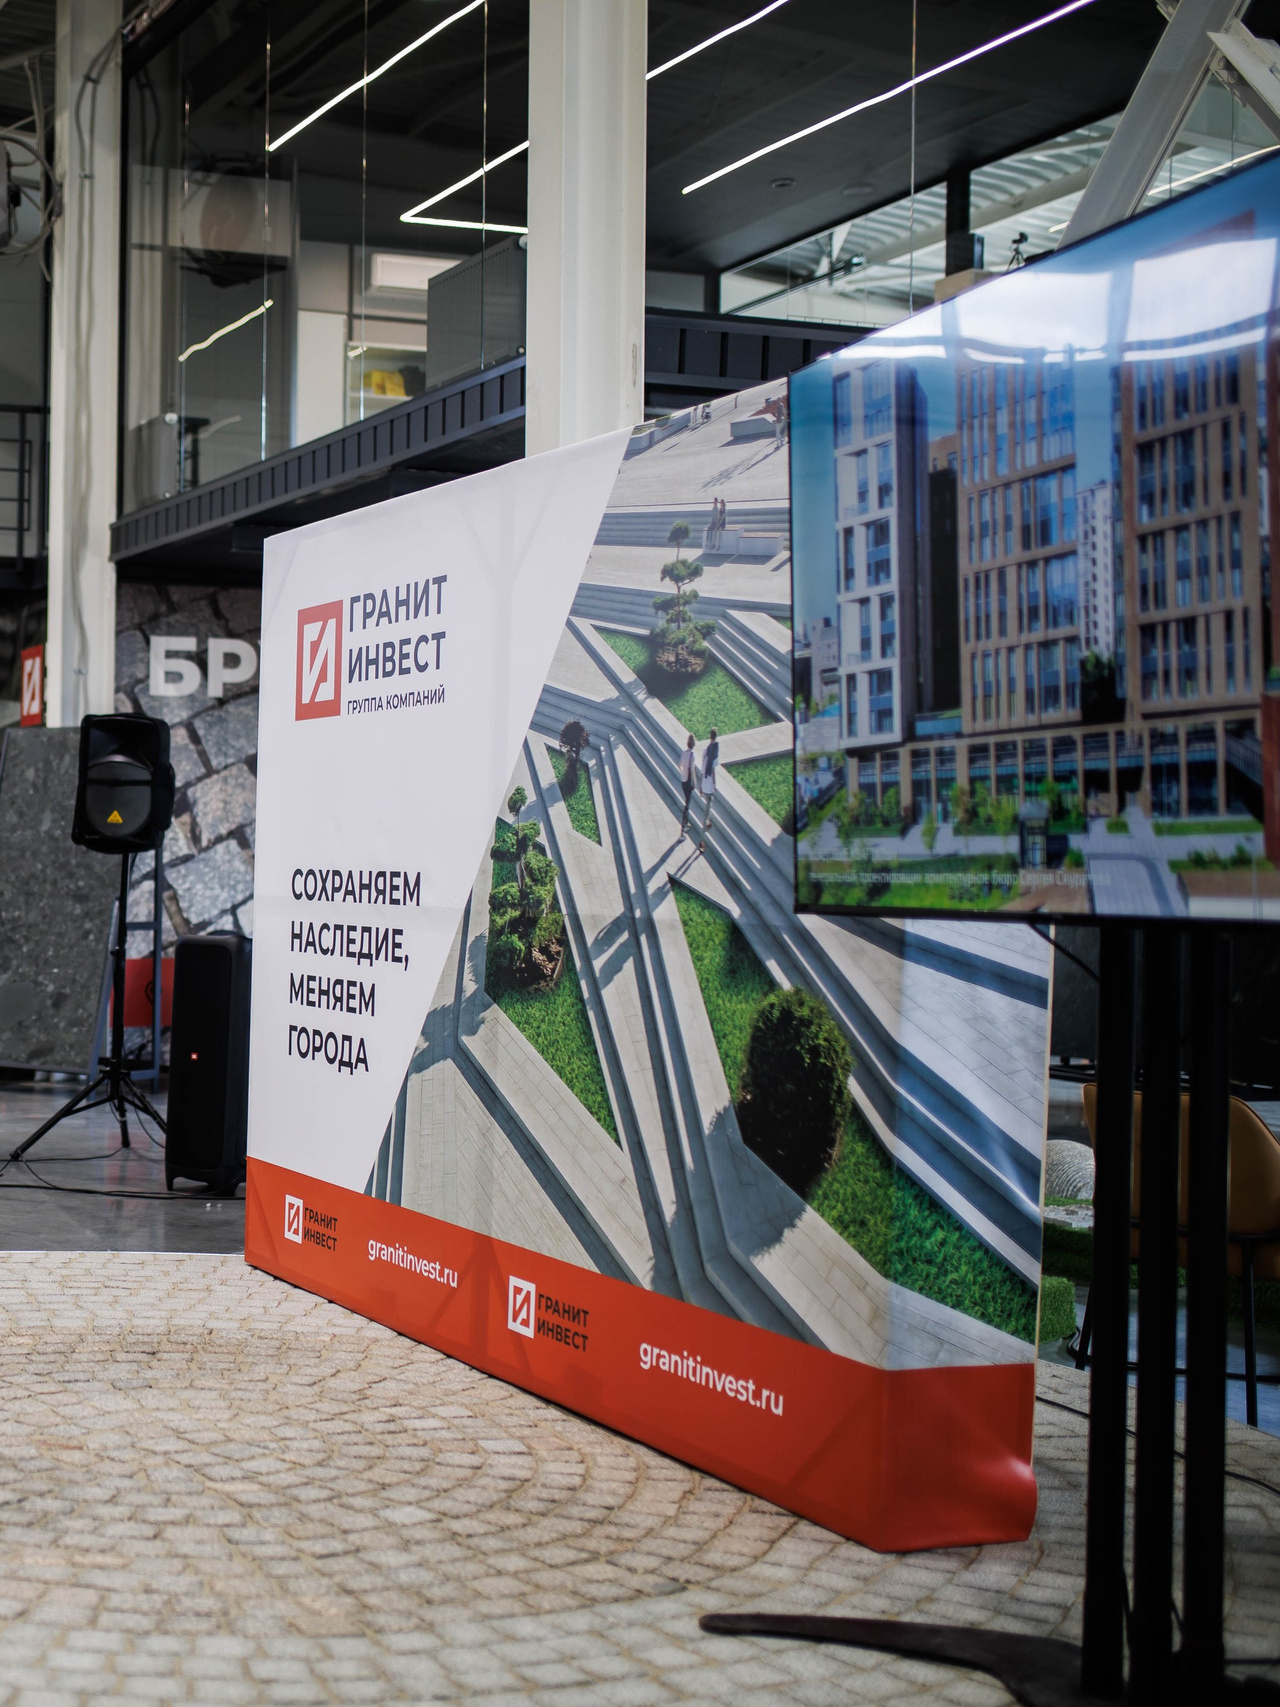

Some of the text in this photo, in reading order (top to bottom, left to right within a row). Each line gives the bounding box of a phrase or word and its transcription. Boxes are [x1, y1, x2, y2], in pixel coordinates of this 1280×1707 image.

[349, 574, 447, 632] ГРАНИТ
[149, 635, 261, 698] БР
[348, 631, 446, 683] ИНВЕСТ
[347, 684, 445, 715] ГРУППА КОМПАНИЙ
[291, 868, 421, 907] СОХРАНЯЕМ
[290, 920, 409, 971] НАСЛЕДИЕ,
[289, 972, 376, 1017] МЕНЯЕМ
[288, 1024, 369, 1075] ГОРОДА
[303, 1226, 338, 1252] ИНВЕСТ
[304, 1207, 338, 1232] ГРАНИТ
[367, 1239, 458, 1289] granitinvest.ru
[537, 1293, 590, 1328] ГРАНИТ
[537, 1316, 589, 1353] ИНВЕСТ
[639, 1342, 785, 1417] granitinvest.ru
